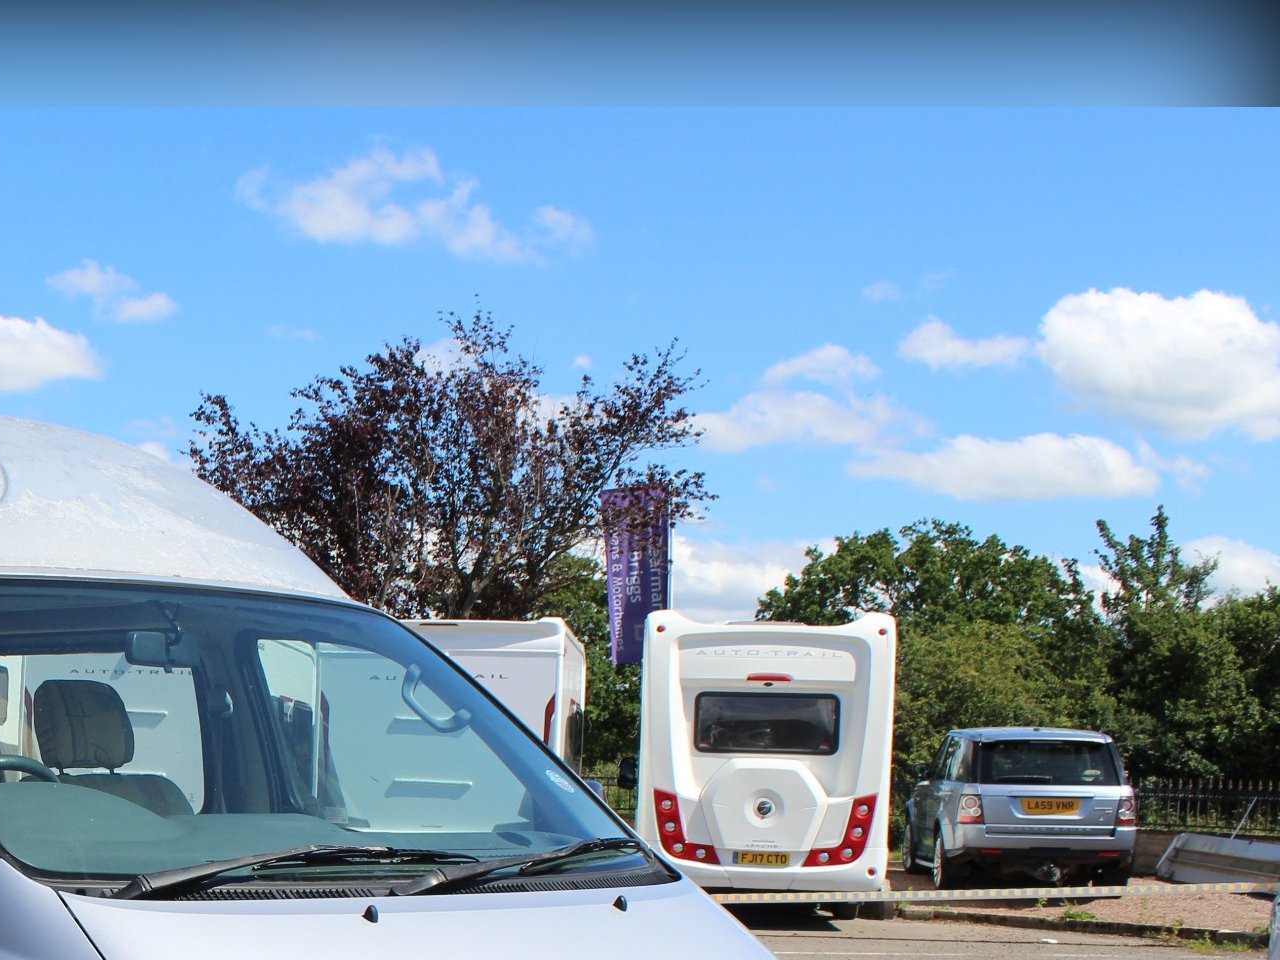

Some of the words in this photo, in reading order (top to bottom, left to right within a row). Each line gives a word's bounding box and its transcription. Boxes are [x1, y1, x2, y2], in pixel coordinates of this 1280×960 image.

[612, 563, 622, 573] &
[626, 550, 643, 603] Briggs
[613, 577, 625, 650] Motorhomes
[695, 649, 842, 658] AUTO-TRAIL
[1027, 801, 1053, 810] LA59
[1055, 801, 1075, 810] VNR
[741, 853, 765, 863] FJ17
[766, 854, 788, 864] CTO
